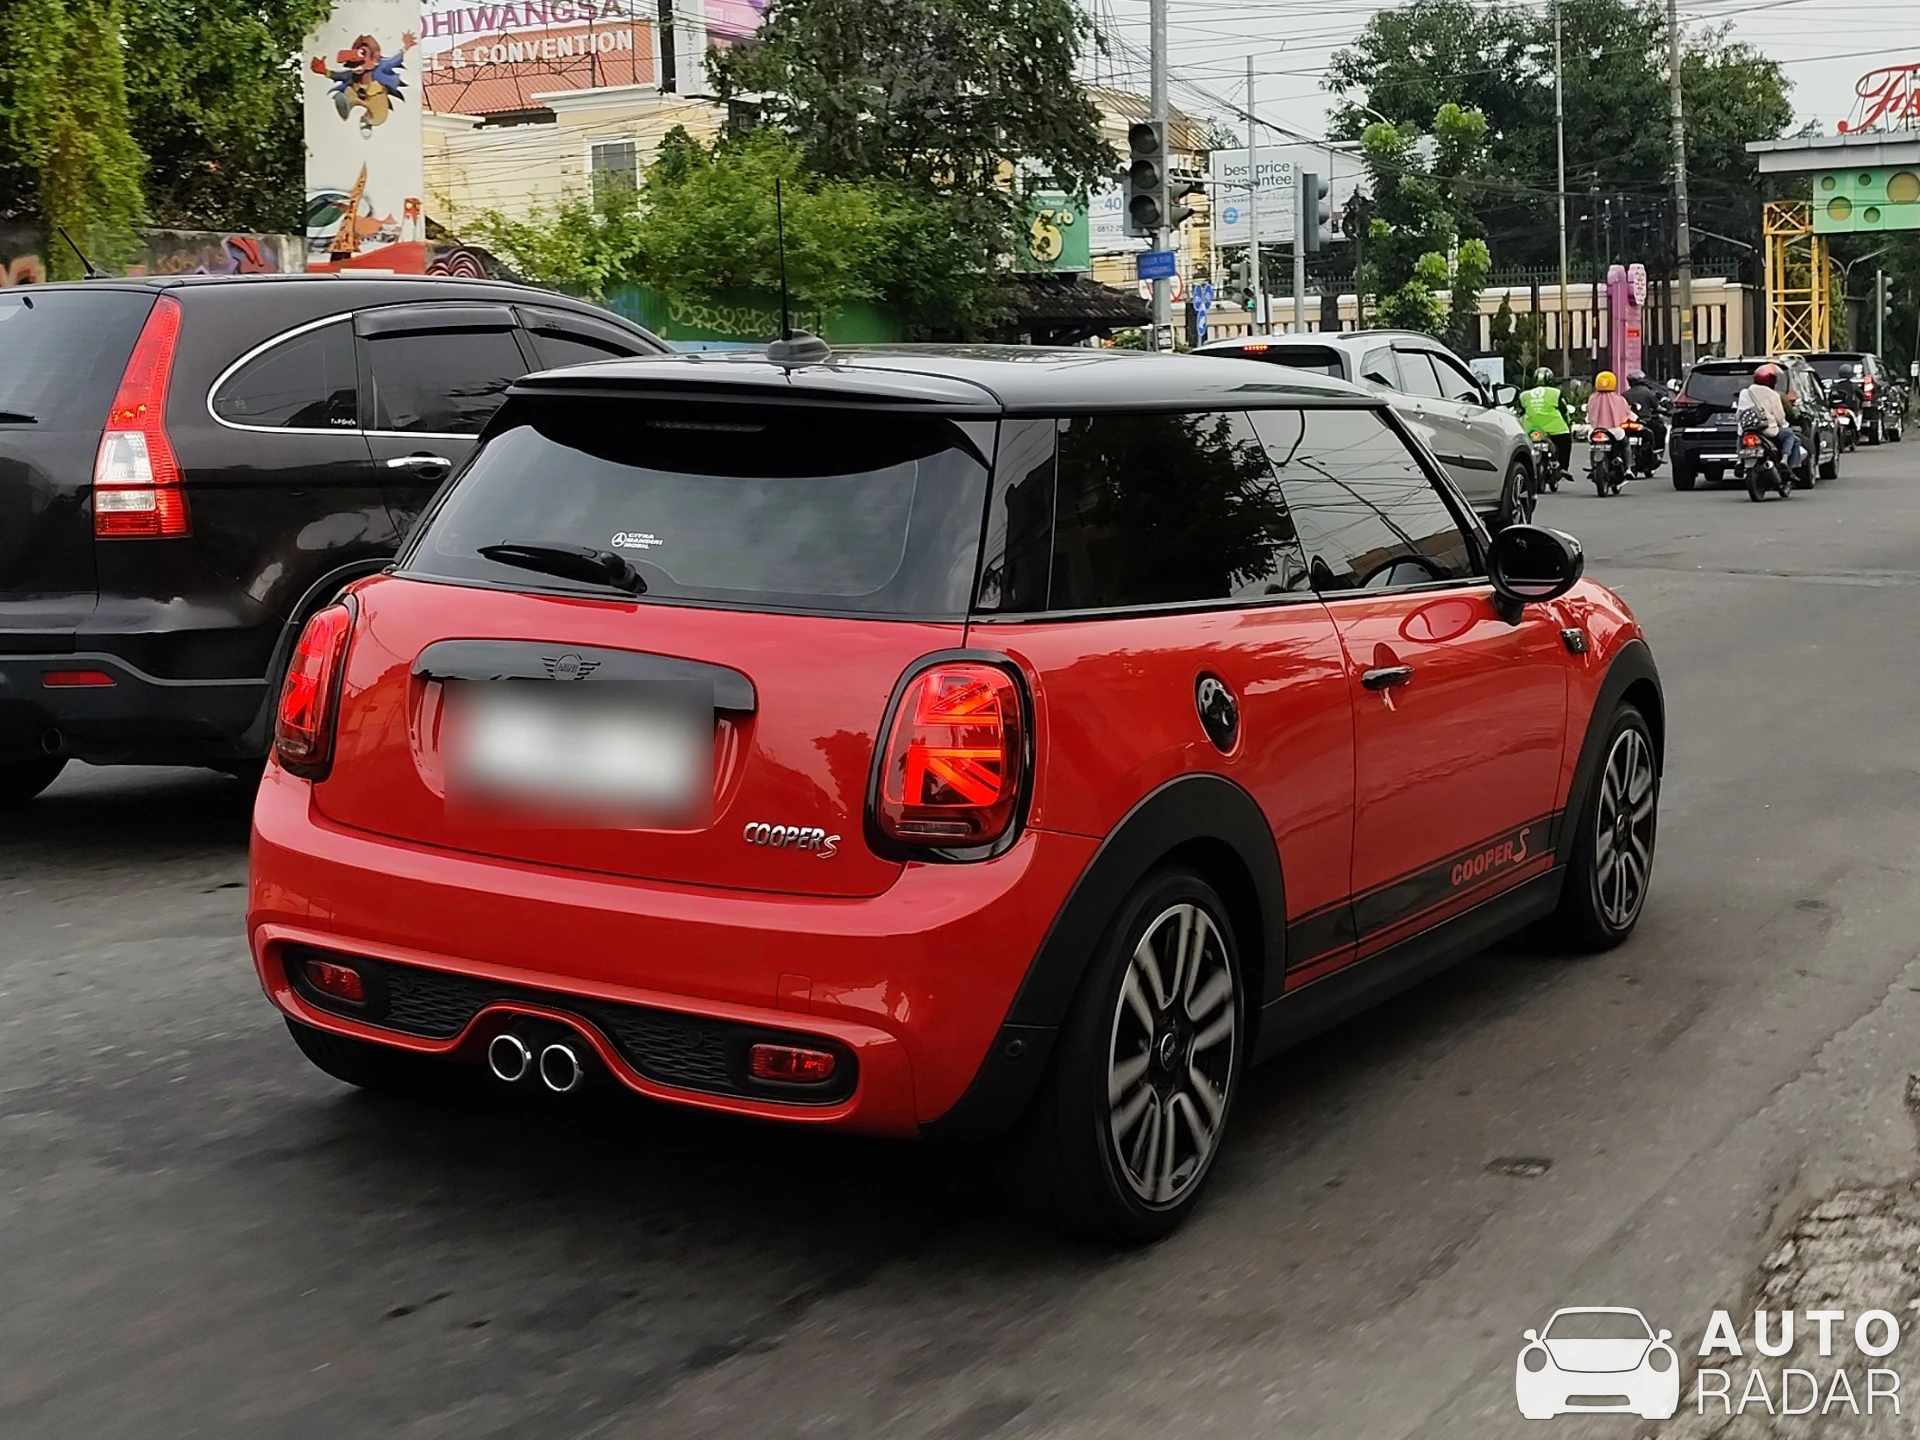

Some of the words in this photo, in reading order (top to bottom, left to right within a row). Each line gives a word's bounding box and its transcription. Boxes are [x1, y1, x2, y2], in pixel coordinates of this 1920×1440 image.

[451, 48, 467, 69] &
[473, 29, 633, 67] CONVENTION
[1224, 163, 1250, 176] bes
[1256, 160, 1290, 178] price
